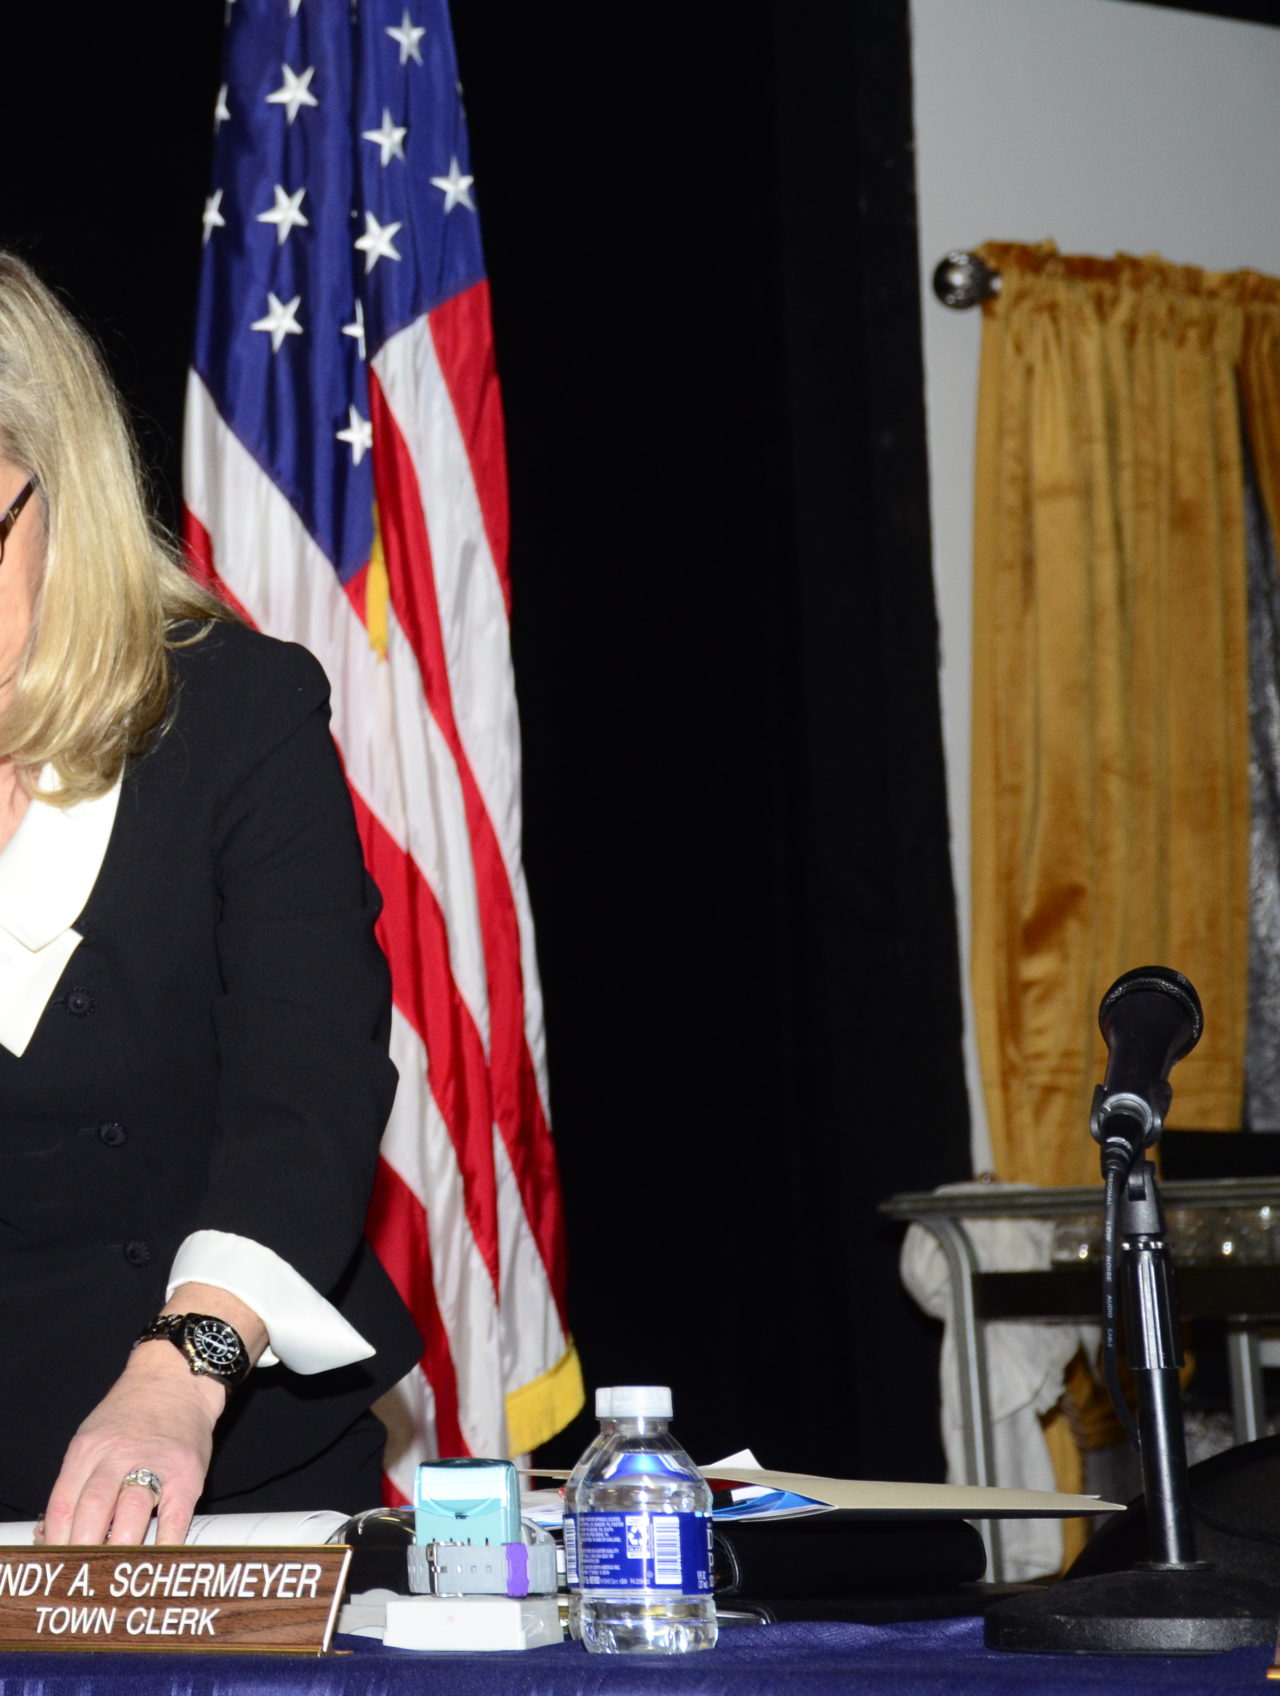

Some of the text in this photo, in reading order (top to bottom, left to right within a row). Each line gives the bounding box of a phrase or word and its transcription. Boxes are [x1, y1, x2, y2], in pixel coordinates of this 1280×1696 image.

[1105, 1221, 1113, 1242] LOW
[1105, 1255, 1113, 1282] NOISE
[1106, 1294, 1114, 1318] AUDIO
[67, 1562, 95, 1597] A.
[109, 1562, 323, 1598] SCHERMEYER
[35, 1606, 221, 1636] TOWN CLERK
